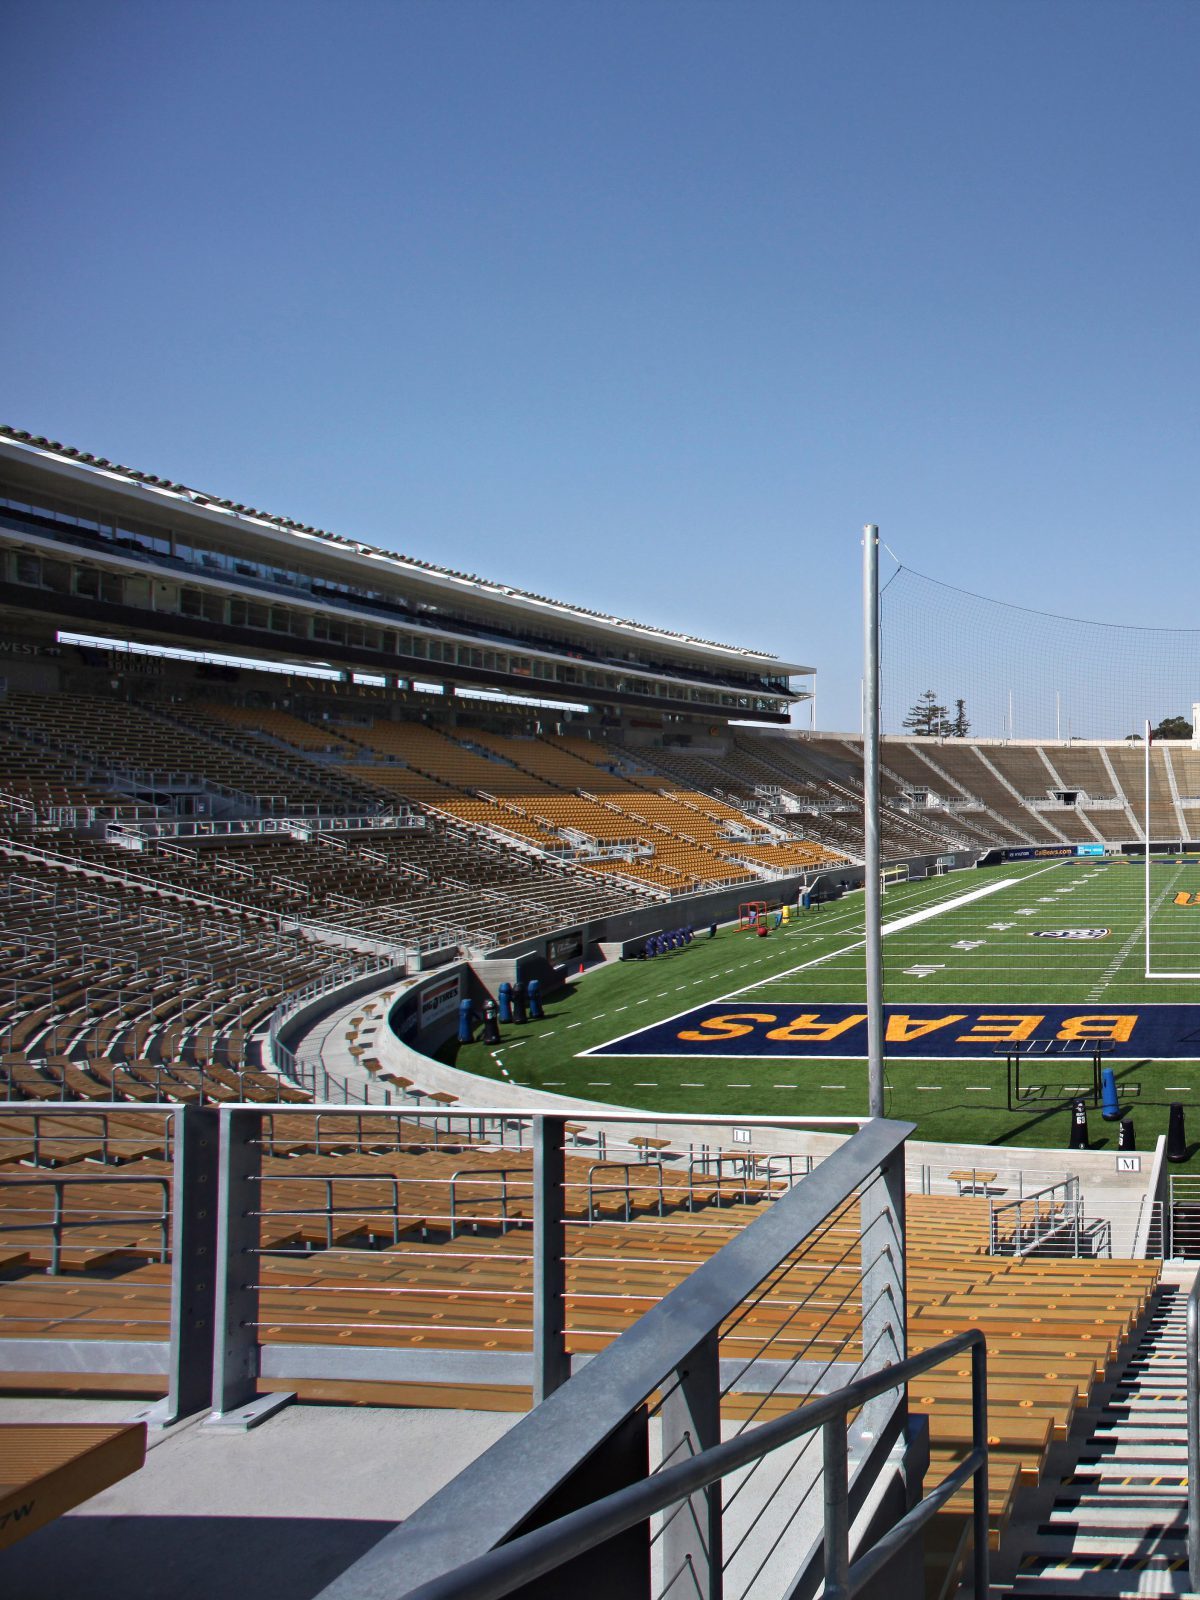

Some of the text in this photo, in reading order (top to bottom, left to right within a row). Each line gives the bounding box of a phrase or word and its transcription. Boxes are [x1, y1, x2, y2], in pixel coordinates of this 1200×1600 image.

[1034, 848, 1073, 858] CalBears.com
[676, 1013, 1139, 1043] BEARS
[1123, 1159, 1134, 1170] M
